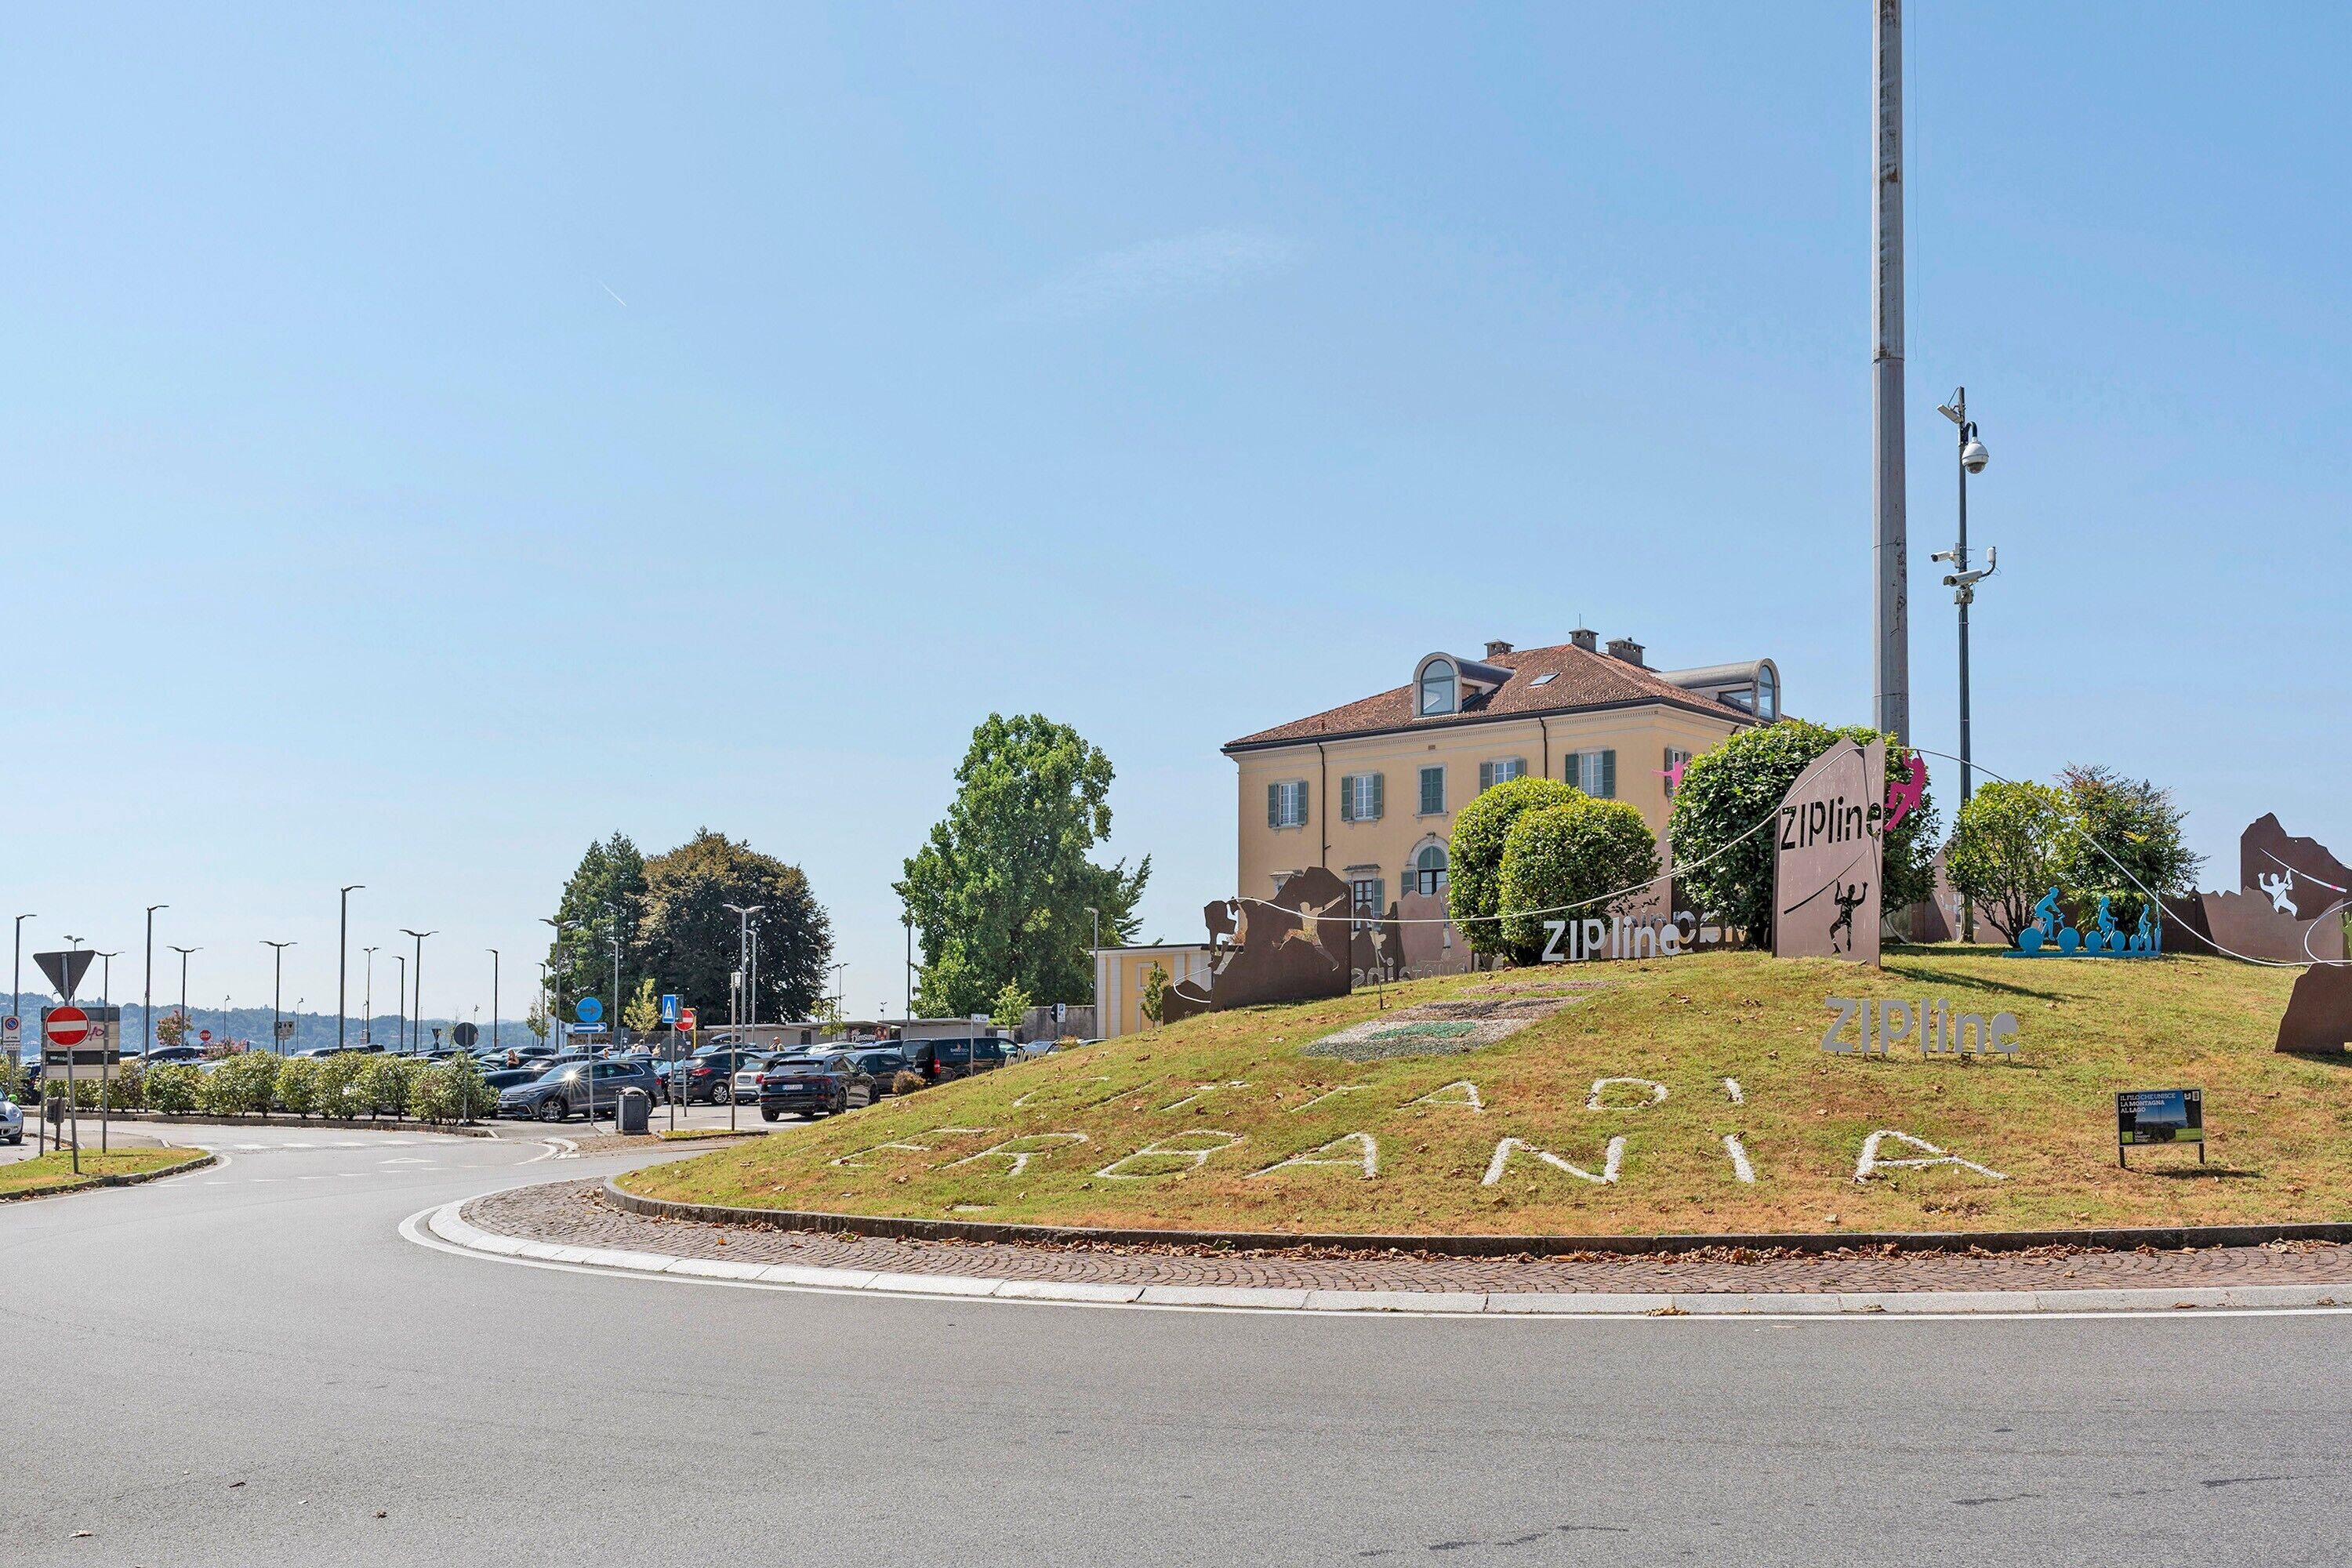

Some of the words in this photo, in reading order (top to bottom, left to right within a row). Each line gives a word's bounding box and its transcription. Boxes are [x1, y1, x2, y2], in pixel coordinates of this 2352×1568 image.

[1780, 796, 1882, 851] ZIPline
[1541, 916, 1682, 961] ZIPline
[1820, 996, 2020, 1054] ZIPline
[1583, 1077, 1746, 1111] DI
